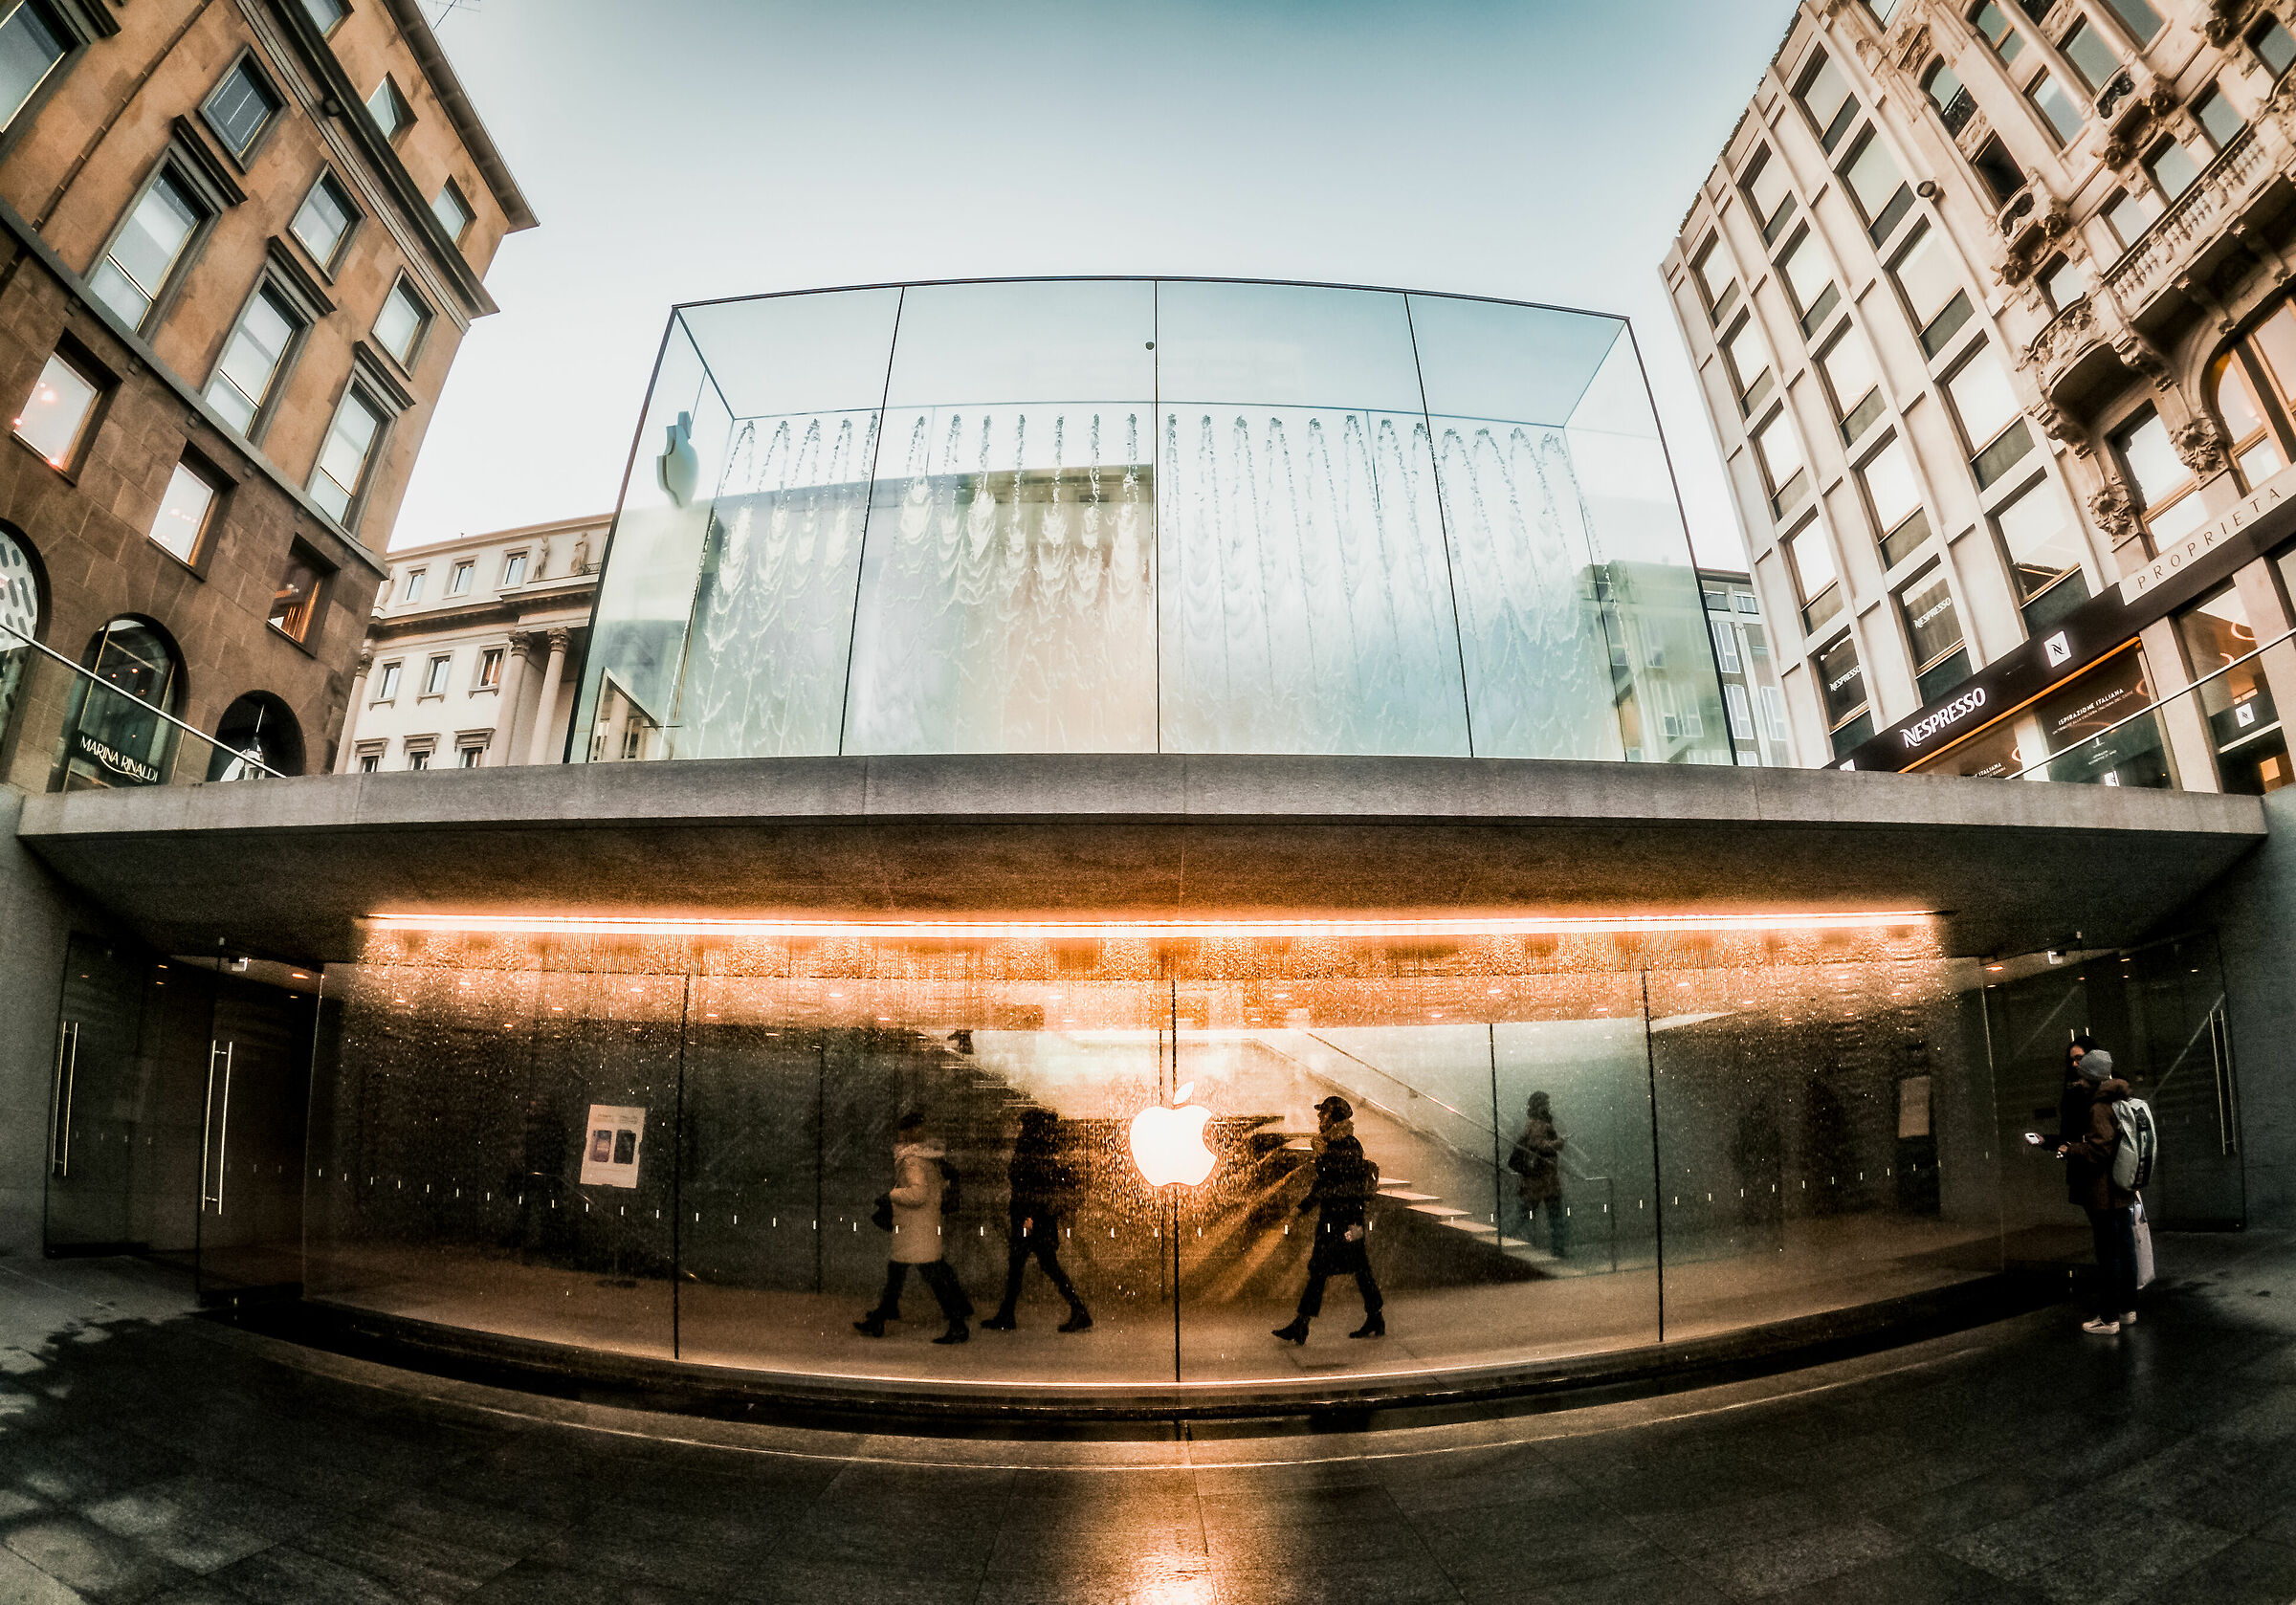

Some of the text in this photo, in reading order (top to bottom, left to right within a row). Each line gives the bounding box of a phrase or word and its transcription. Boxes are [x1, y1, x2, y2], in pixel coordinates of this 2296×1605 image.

[2137, 488, 2281, 589] PROPRIETA
[1913, 597, 1952, 628] NESPRESSO
[1899, 687, 1987, 749] NESPRESSO
[2058, 702, 2095, 726] ISPIRAZIONE
[2095, 688, 2124, 706] ITALIANA
[80, 736, 158, 782] MARINA RINALDI
